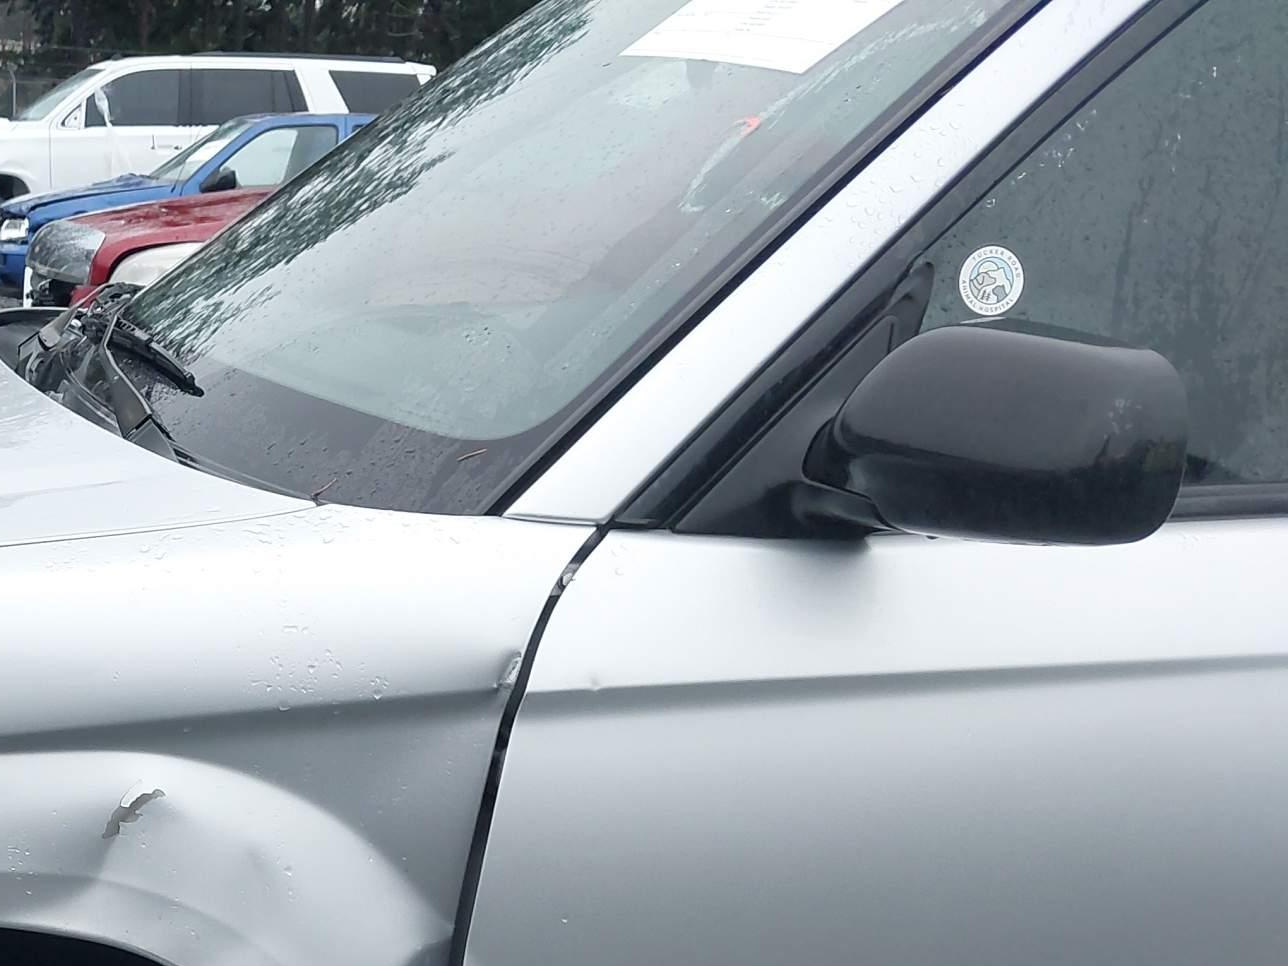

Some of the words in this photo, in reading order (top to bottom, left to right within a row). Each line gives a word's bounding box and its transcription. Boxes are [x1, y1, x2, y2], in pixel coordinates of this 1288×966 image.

[972, 249, 1005, 261] TUCKER
[1007, 255, 1021, 278] ROAD
[961, 279, 978, 308] ANIMAL
[979, 298, 1014, 313] HOSPITAL
